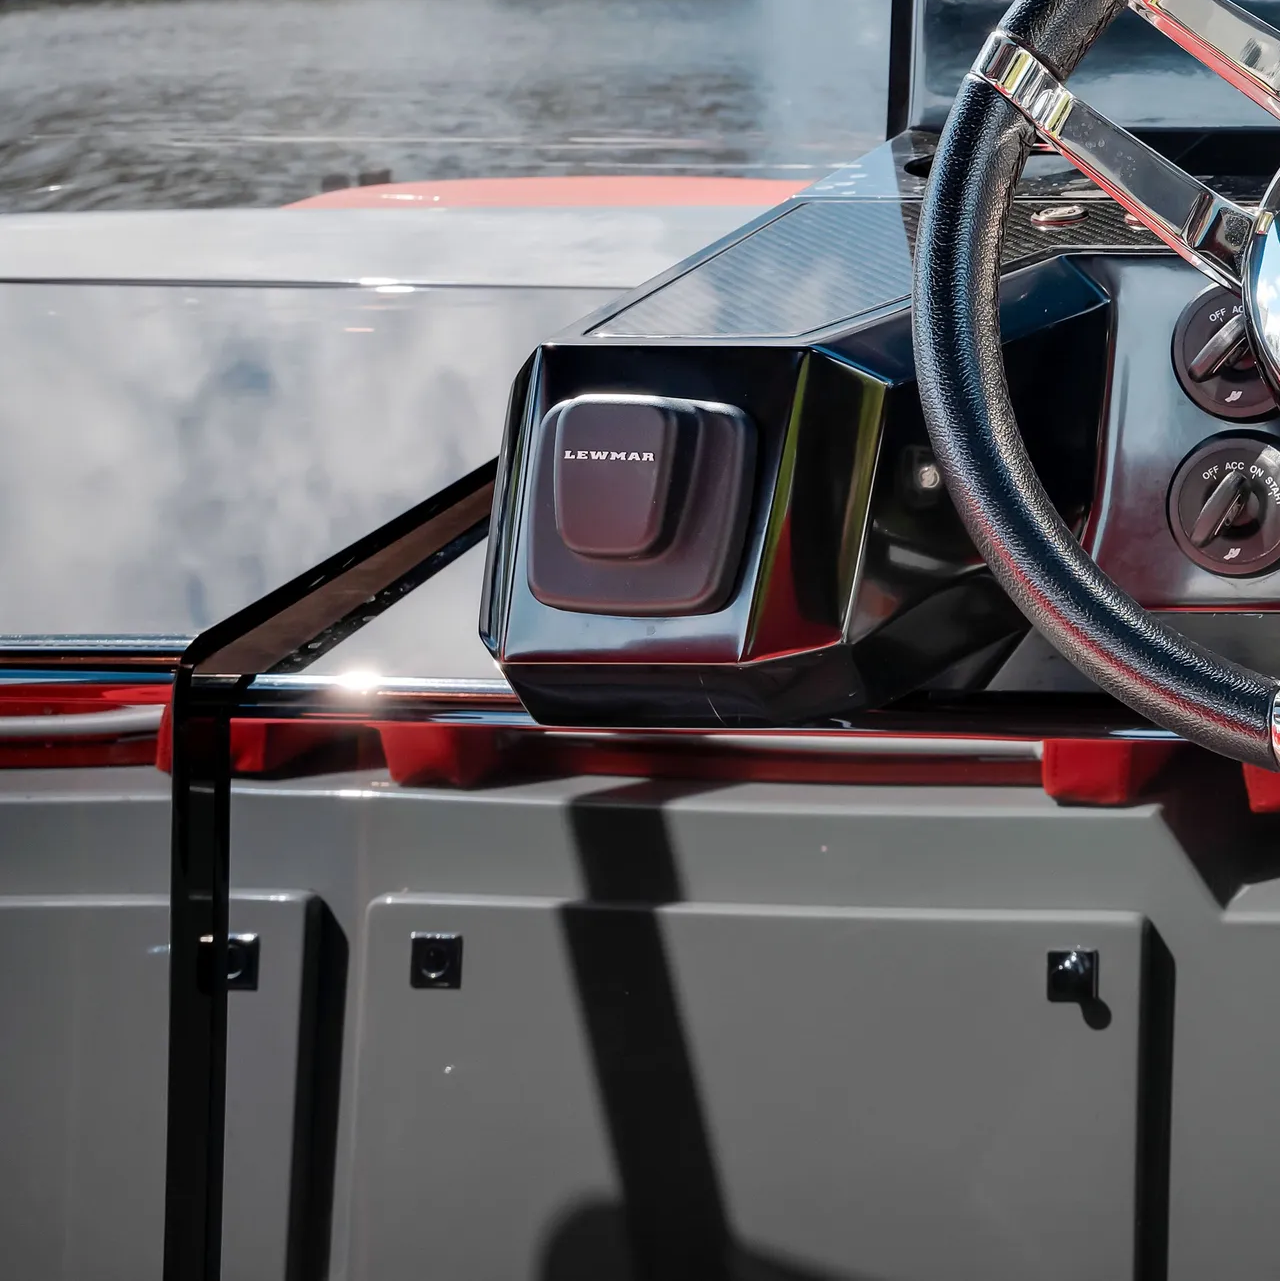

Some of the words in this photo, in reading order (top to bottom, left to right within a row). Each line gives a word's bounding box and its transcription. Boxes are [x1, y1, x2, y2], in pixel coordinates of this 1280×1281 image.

[1209, 307, 1227, 322] OFF
[1232, 305, 1244, 314] AC
[564, 450, 655, 462] LEWMAR
[1202, 465, 1220, 480] OFF
[1224, 461, 1245, 471] ACC
[1249, 465, 1265, 478] ON
